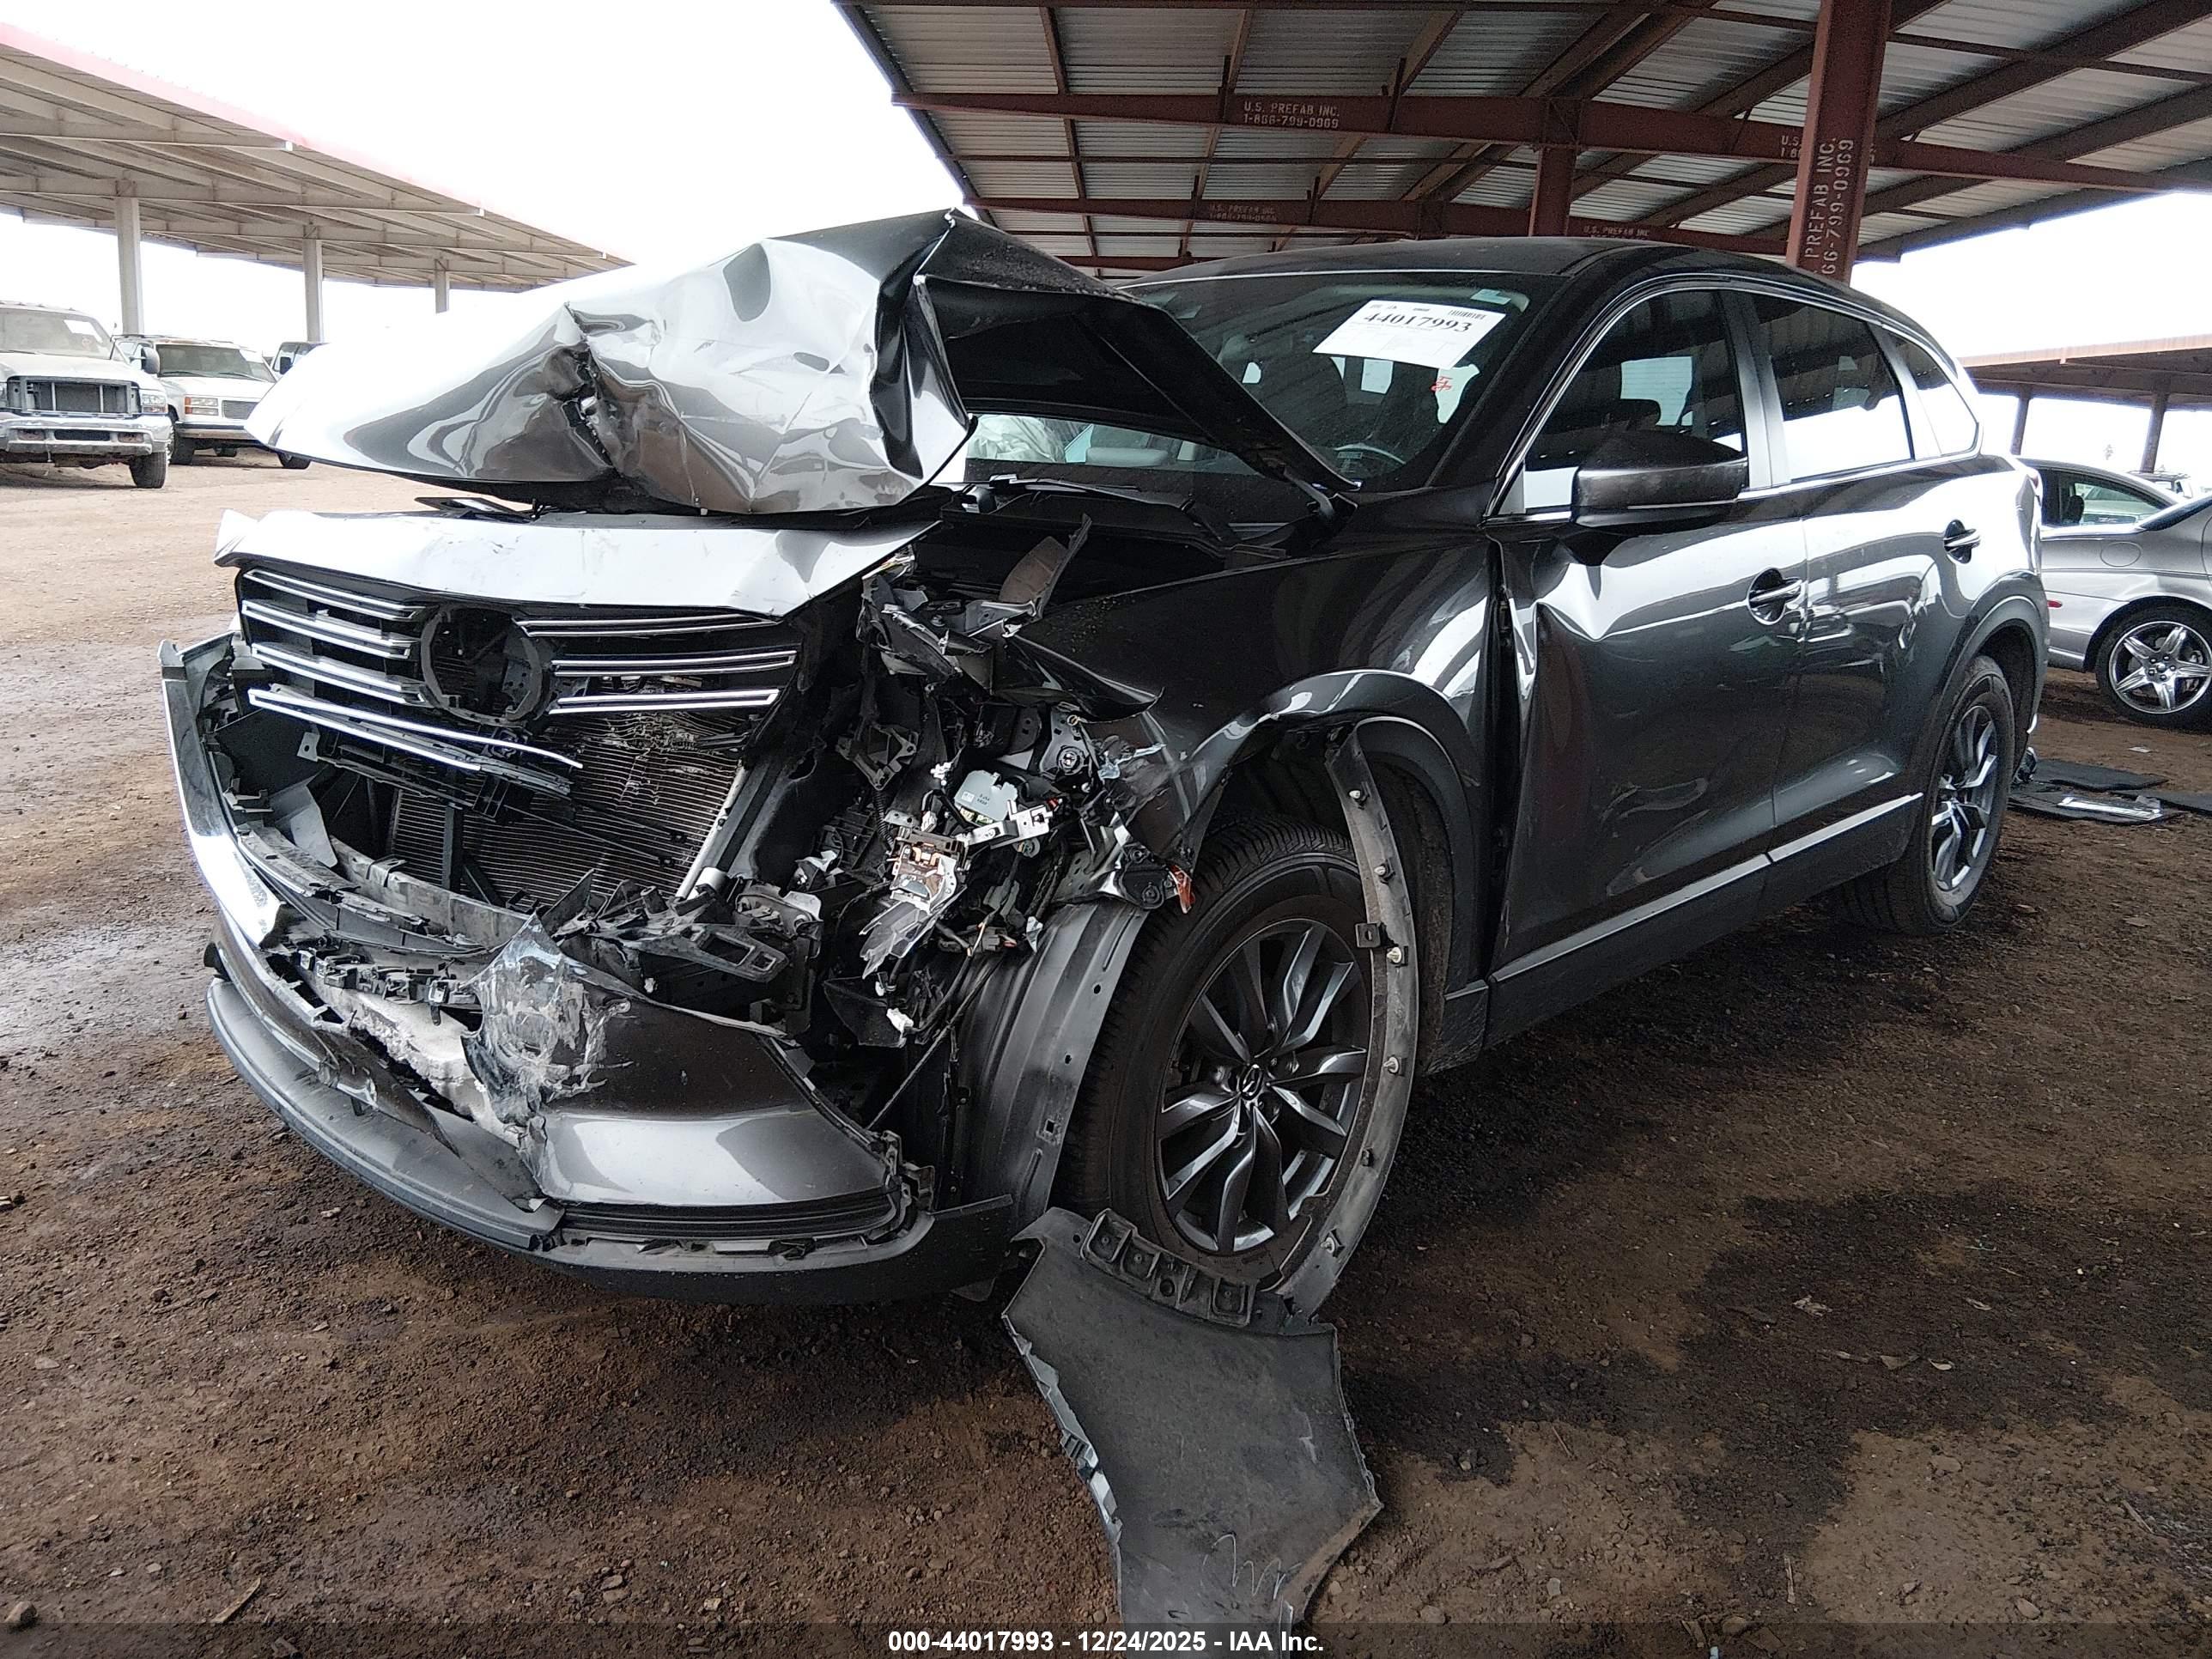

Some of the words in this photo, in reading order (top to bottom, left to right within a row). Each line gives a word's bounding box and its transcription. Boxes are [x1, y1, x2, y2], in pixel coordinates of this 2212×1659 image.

[1243, 100, 1265, 112] U.S.
[1271, 102, 1314, 115] PREFAB
[1319, 105, 1340, 117] INC.
[1816, 137, 1837, 173] INC.
[1804, 184, 1829, 258] PREFAB
[1363, 313, 1473, 332] 44017993
